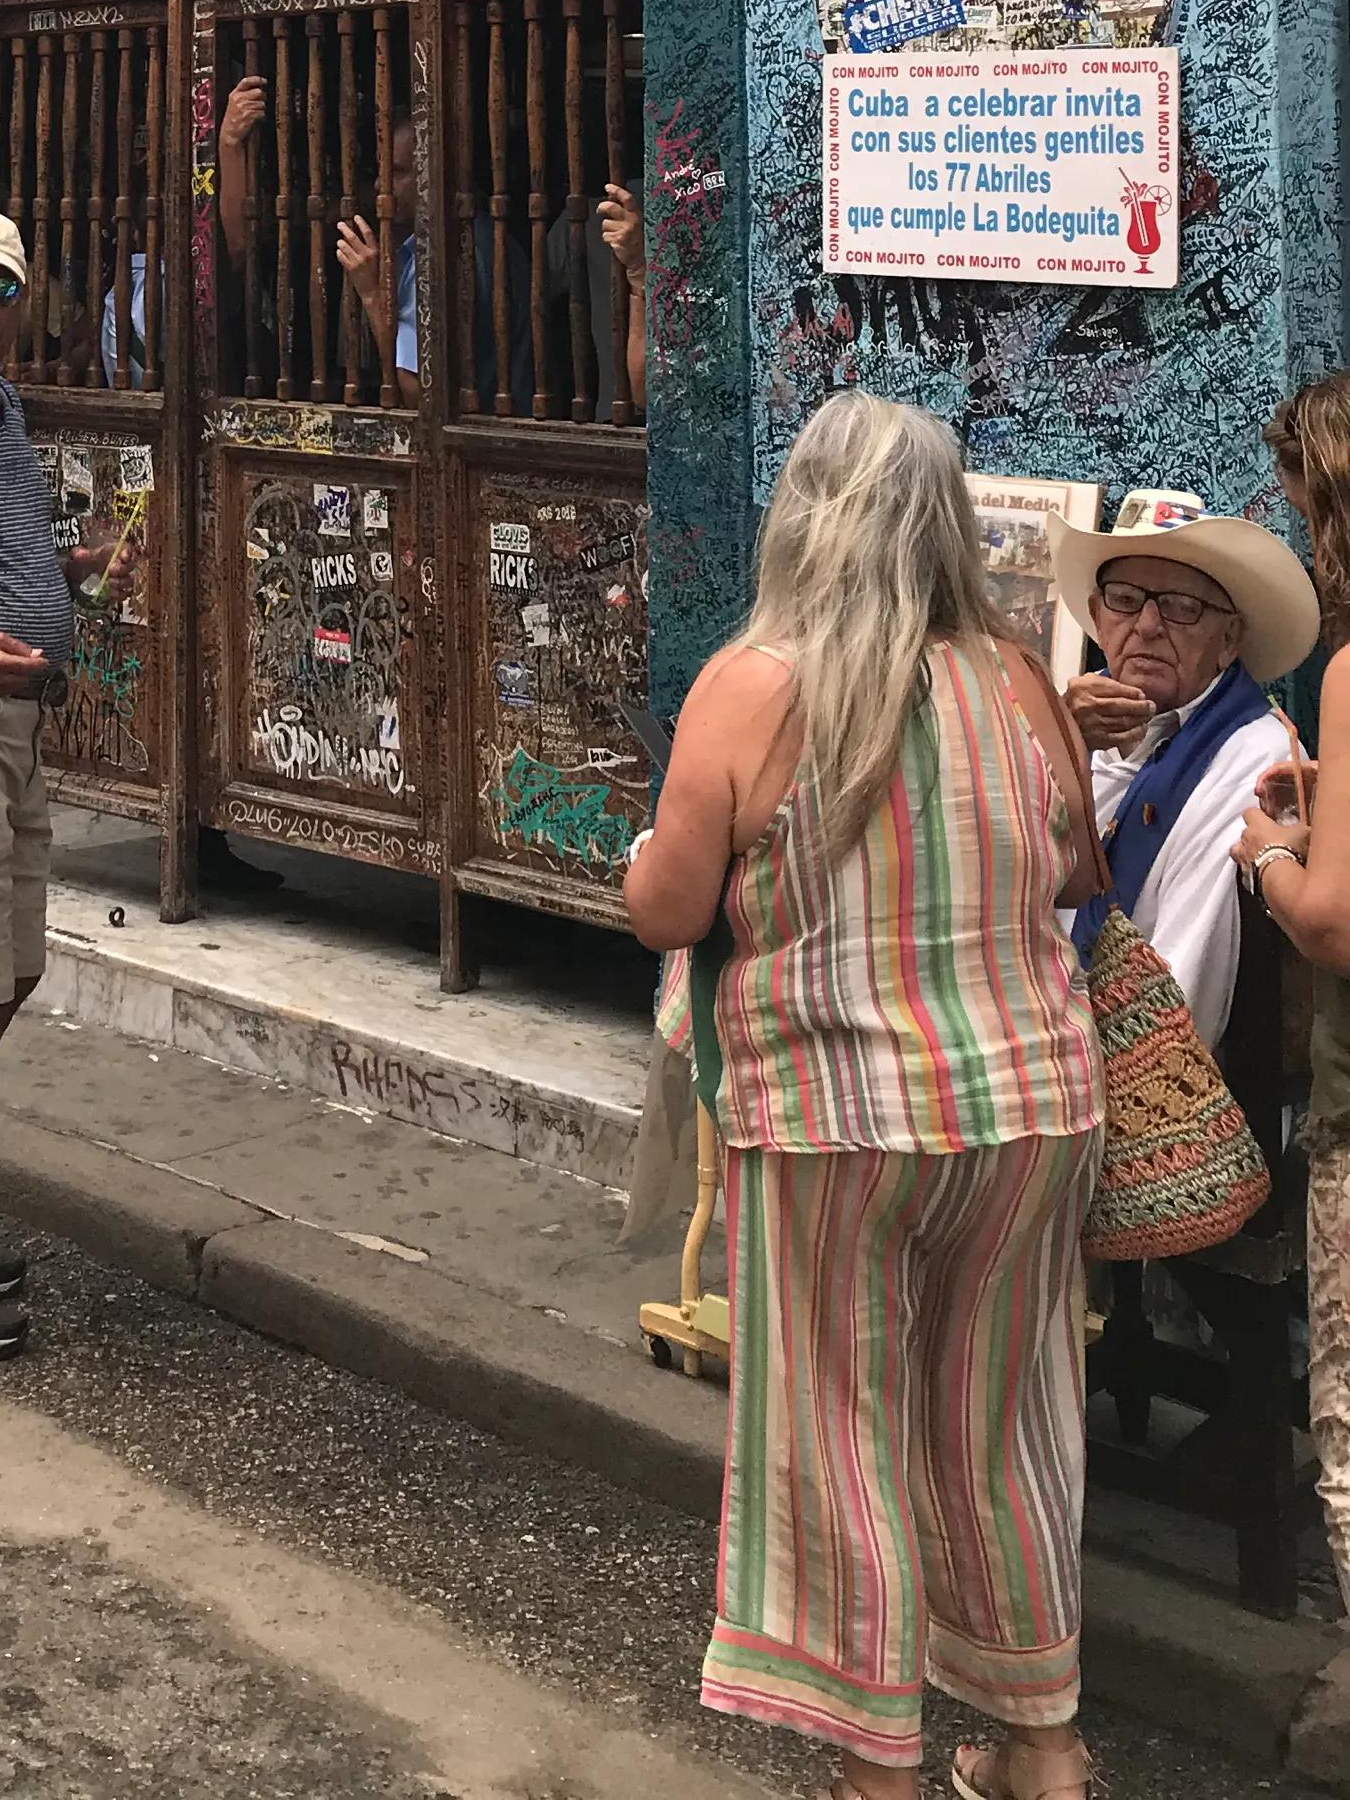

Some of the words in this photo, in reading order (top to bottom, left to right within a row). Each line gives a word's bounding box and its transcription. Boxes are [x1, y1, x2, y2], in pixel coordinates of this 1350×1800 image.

[832, 66, 857, 78] CON
[858, 65, 899, 78] MOJITO
[909, 65, 934, 78] CON
[936, 64, 980, 78] MOJITO
[993, 63, 1019, 76] CON
[1022, 62, 1068, 75] MOJITO
[1082, 61, 1108, 74] CON
[1112, 61, 1158, 74] MOJITO
[848, 88, 908, 117] Cuba
[925, 93, 939, 117] a
[948, 88, 1057, 117] celebrar
[1065, 87, 1141, 117] invita
[1157, 71, 1169, 105] CON
[830, 87, 840, 138] MOJITO
[829, 142, 840, 171] CON
[851, 129, 890, 153] con
[898, 130, 936, 153] sus
[944, 124, 1036, 154] clientes
[1045, 124, 1144, 161] gentiles
[1158, 110, 1170, 173] MOJITO
[908, 162, 938, 191] los
[945, 162, 970, 192] 77
[976, 164, 1050, 193] Abriles
[829, 177, 839, 229] MOJITO
[847, 206, 883, 233] que
[890, 202, 965, 236] cumple
[973, 202, 998, 232] La
[1006, 203, 1119, 242] Bodeguita
[829, 233, 839, 262] CON
[845, 250, 872, 263] CON
[876, 252, 925, 265] MOJITO
[937, 254, 964, 267] CON
[969, 255, 1021, 269] MOJITO
[1037, 257, 1067, 271] CON
[1071, 259, 1126, 273] MOJITO
[981, 492, 1005, 508] del
[1007, 494, 1060, 513] Medio
[50, 516, 81, 549] ICKS
[311, 553, 358, 588] RICKS
[490, 552, 539, 591] RICKS
